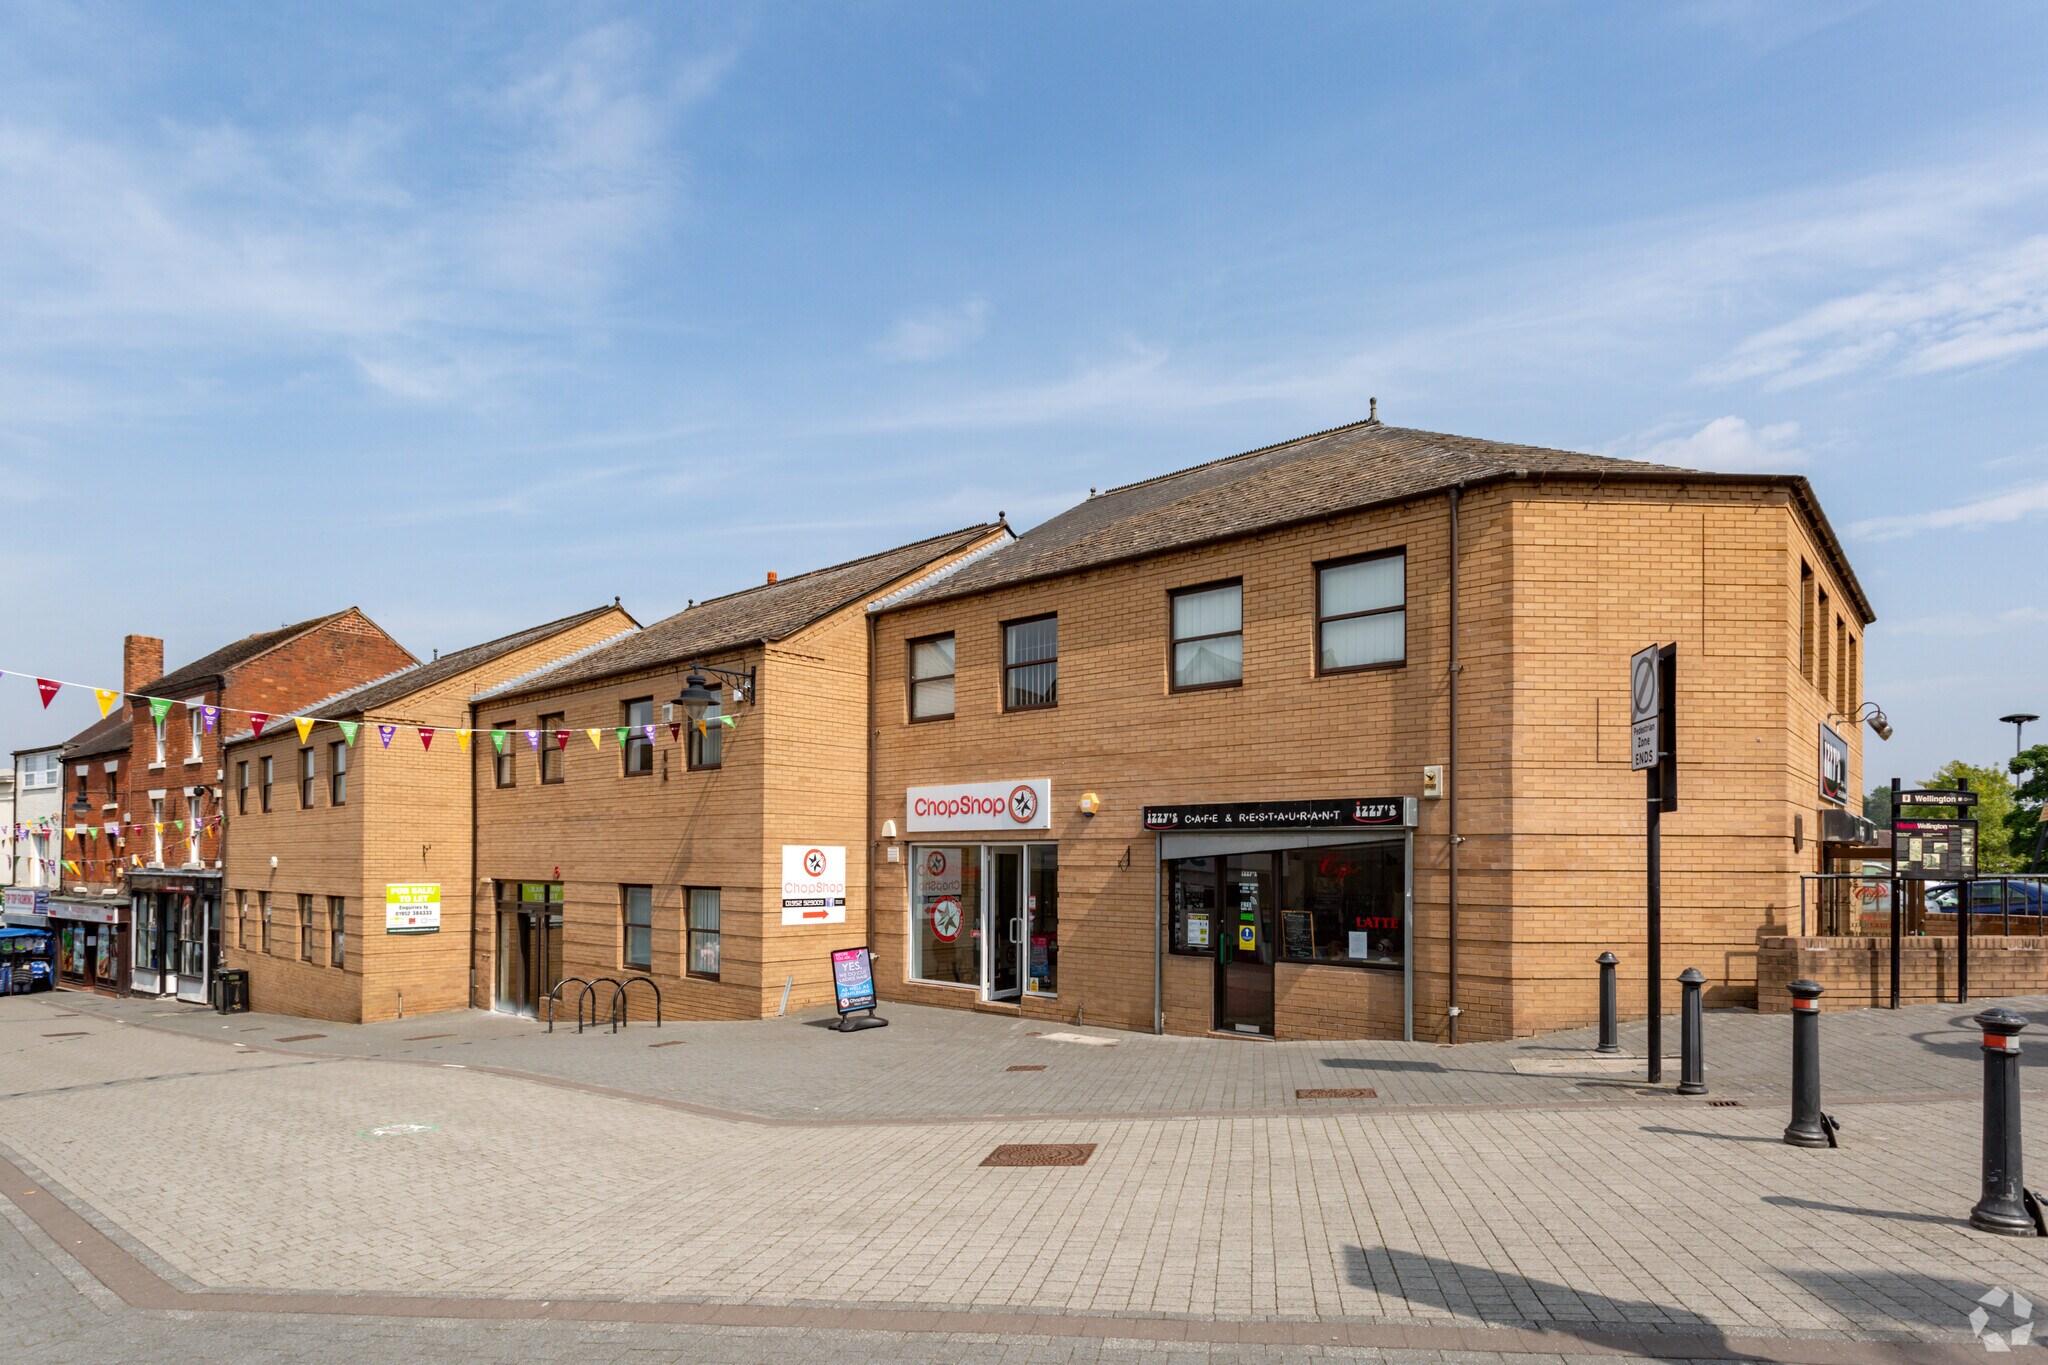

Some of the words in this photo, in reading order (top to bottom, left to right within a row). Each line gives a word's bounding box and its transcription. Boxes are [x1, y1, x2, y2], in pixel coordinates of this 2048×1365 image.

[1633, 723, 1656, 735] Pedestrian
[1637, 737, 1650, 748] Zone
[1635, 750, 1653, 765] ENDS
[1914, 794, 1957, 804] Wellington
[914, 795, 1006, 818] ChopShop
[1225, 813, 1233, 823] &
[391, 887, 409, 895] FOR
[412, 887, 437, 895] SALE/
[784, 882, 844, 895] ChopShop
[1356, 916, 1398, 929] LATTE
[842, 961, 863, 971] YES,
[840, 989, 870, 998] GENTLEMEN
[850, 996, 872, 1004] ChopShop
